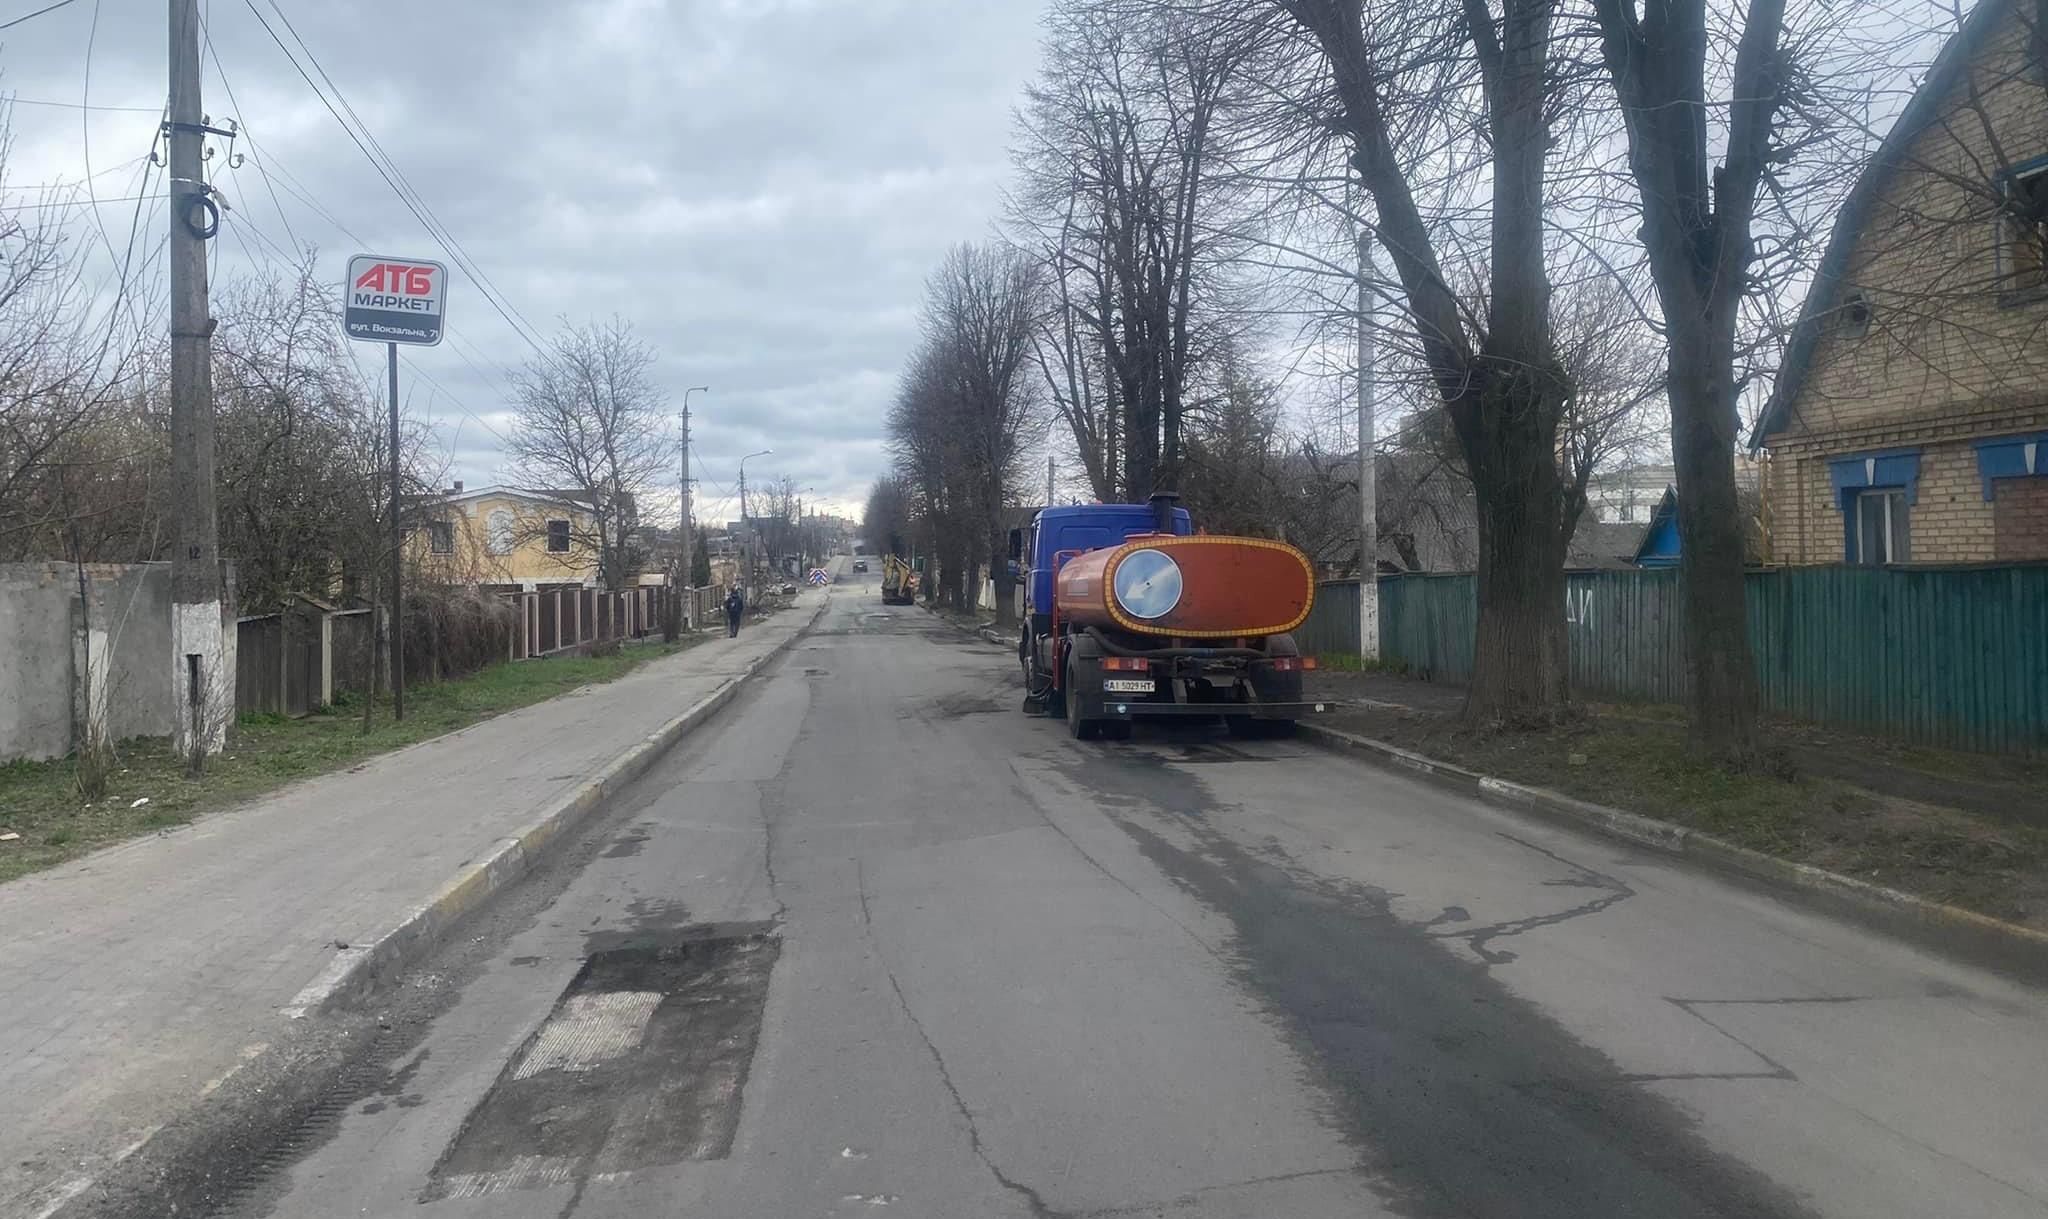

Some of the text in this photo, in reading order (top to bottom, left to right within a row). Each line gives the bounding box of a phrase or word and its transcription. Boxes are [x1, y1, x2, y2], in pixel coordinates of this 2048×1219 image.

[356, 263, 437, 296] АТБ
[354, 293, 435, 311] МАРКЕТ
[350, 323, 369, 332] вул.
[372, 323, 428, 338] Вокзальна,
